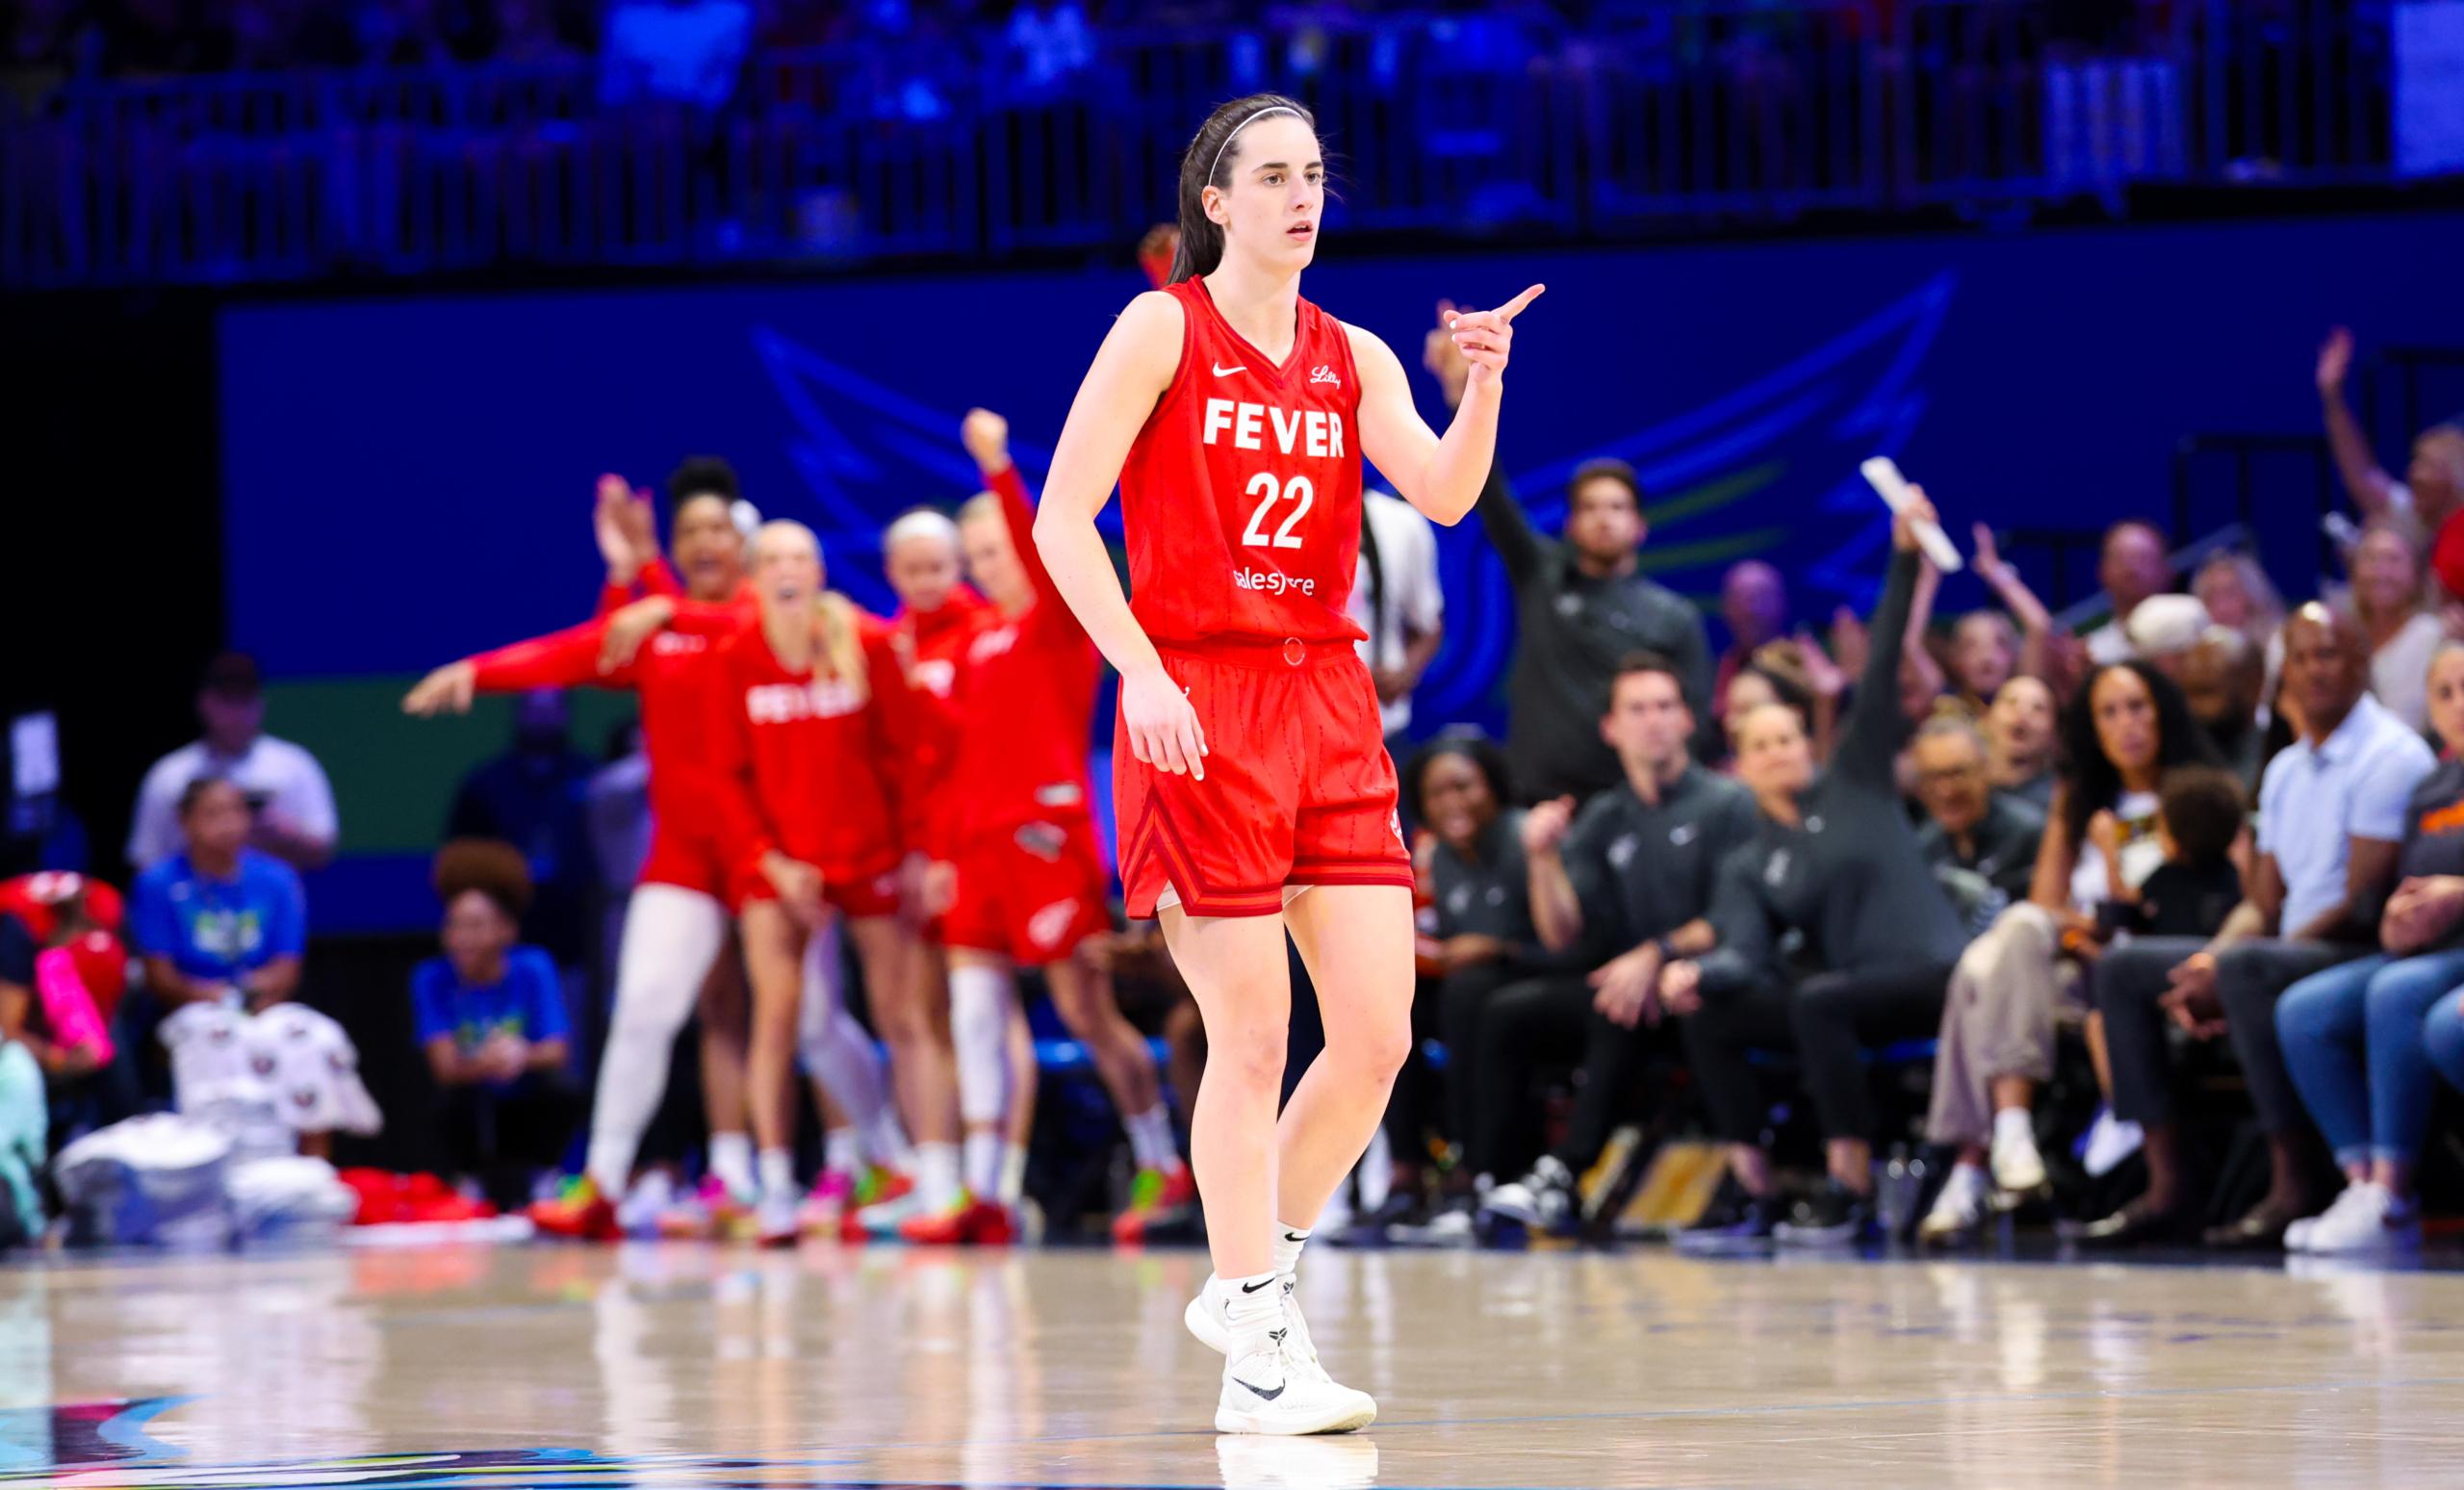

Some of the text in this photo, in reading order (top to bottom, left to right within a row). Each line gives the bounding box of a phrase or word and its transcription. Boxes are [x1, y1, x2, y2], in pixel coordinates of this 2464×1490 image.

[1310, 365, 1342, 390] Lilly
[1203, 398, 1345, 458] FEVER
[1242, 472, 1314, 549] 22
